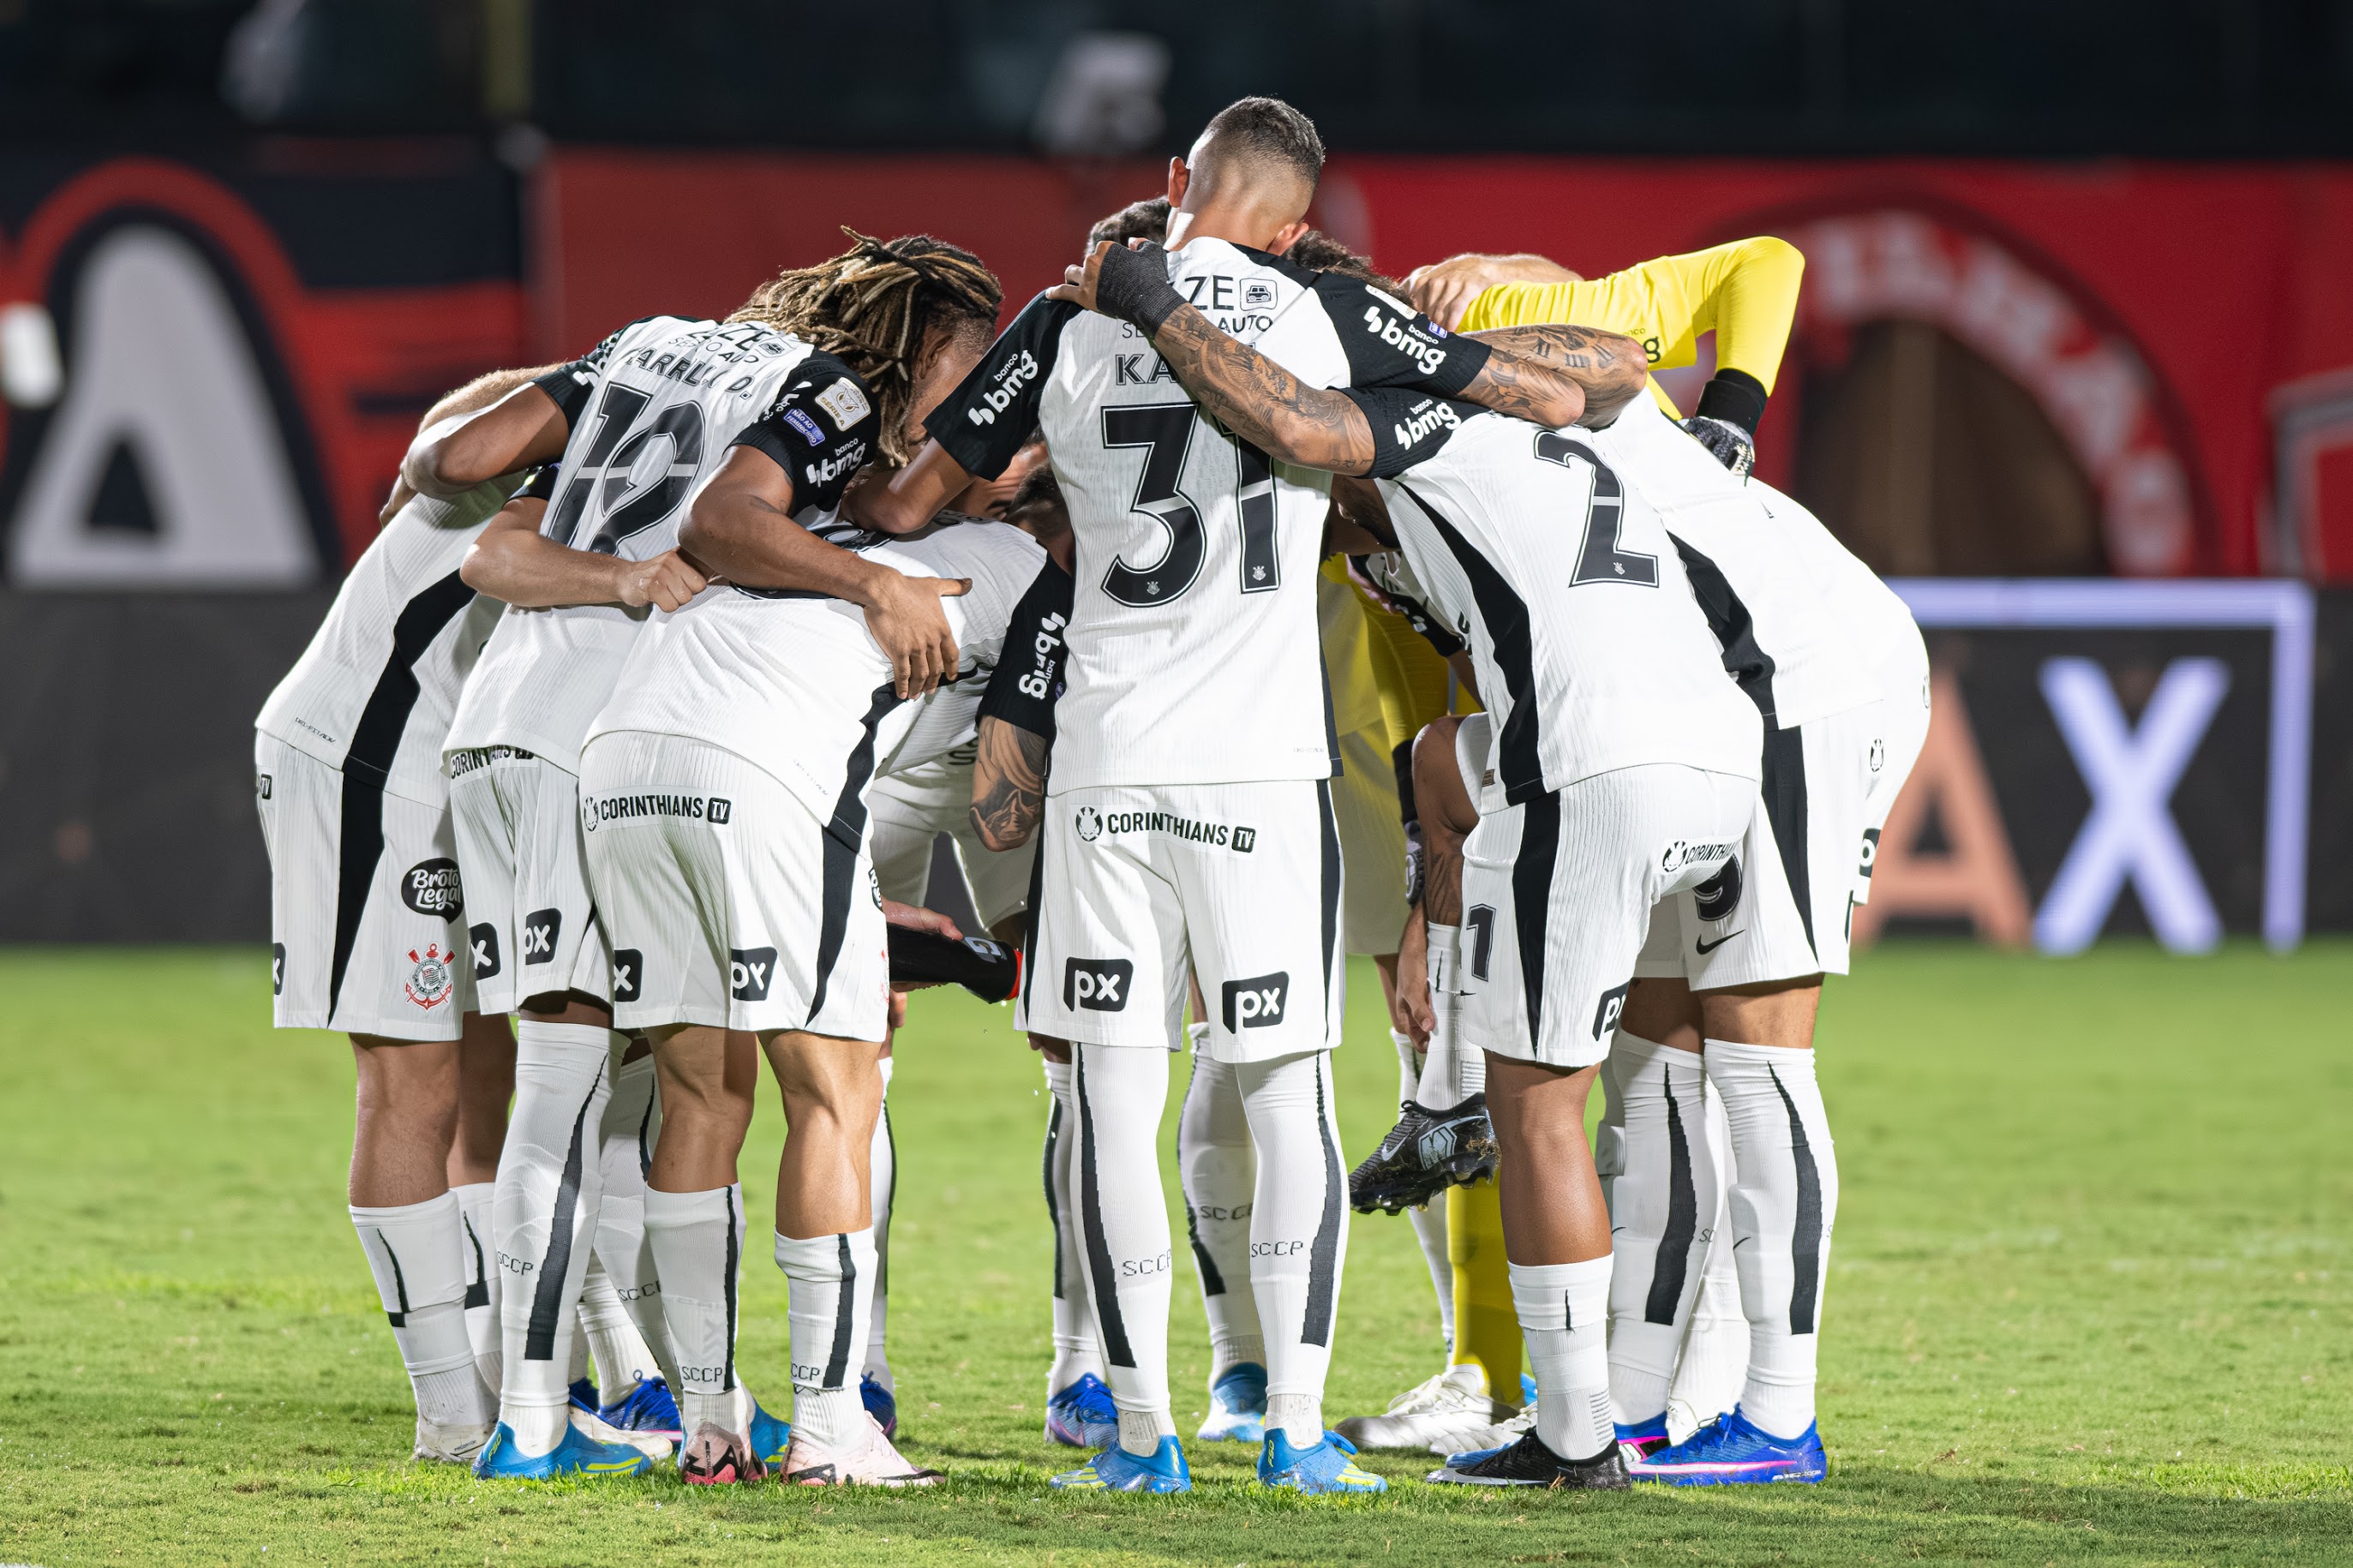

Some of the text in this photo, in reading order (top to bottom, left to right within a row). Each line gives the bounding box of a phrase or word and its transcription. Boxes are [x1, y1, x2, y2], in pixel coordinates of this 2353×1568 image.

[1218, 314, 1274, 334] AUTO
[1408, 324, 1439, 344] banco
[1380, 317, 1447, 375] bmg
[994, 353, 1019, 382] banco
[983, 350, 1039, 413] bmg
[792, 409, 805, 422] NÃO
[1410, 398, 1434, 415] banco
[1404, 402, 1462, 444] bmg
[835, 438, 859, 457] banco
[546, 380, 706, 557] 19
[821, 442, 866, 481] bmg
[1101, 402, 1280, 607] 31
[1534, 429, 1659, 589] 2
[601, 794, 727, 821] CORINTHIANS TV
[1107, 812, 1254, 848] CORINTHIANS TV
[411, 868, 459, 889] Broto
[416, 883, 462, 910] Legal
[1074, 969, 1121, 1012] px
[1235, 987, 1280, 1033] px
[1251, 1241, 1303, 1258] SCCP
[497, 1251, 534, 1276] SCCP
[681, 1366, 723, 1382] SCCP
[791, 1363, 820, 1380] CCP
